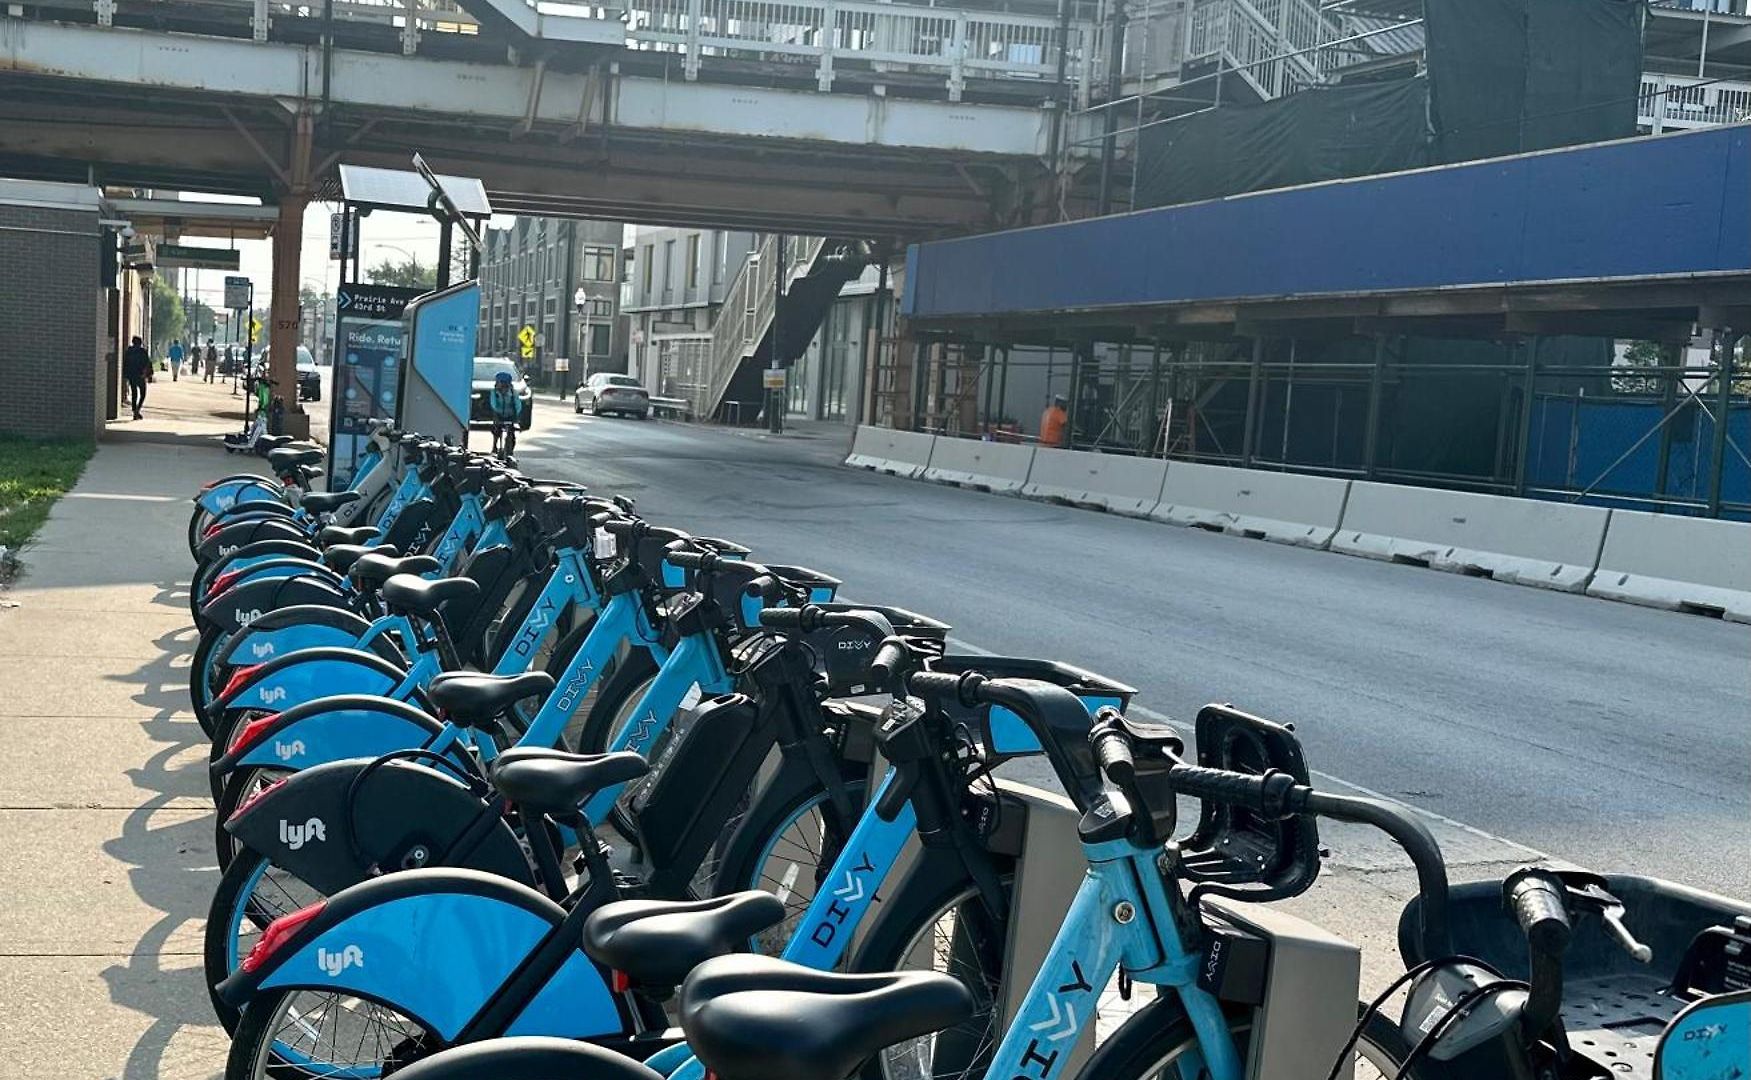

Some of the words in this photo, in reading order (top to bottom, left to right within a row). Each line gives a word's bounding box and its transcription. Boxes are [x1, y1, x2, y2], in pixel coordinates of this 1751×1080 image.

[354, 294, 386, 303] Prairie
[260, 686, 286, 704] lyft
[275, 740, 306, 760] lyft
[280, 817, 326, 850] lyft
[318, 944, 363, 977] lyft
